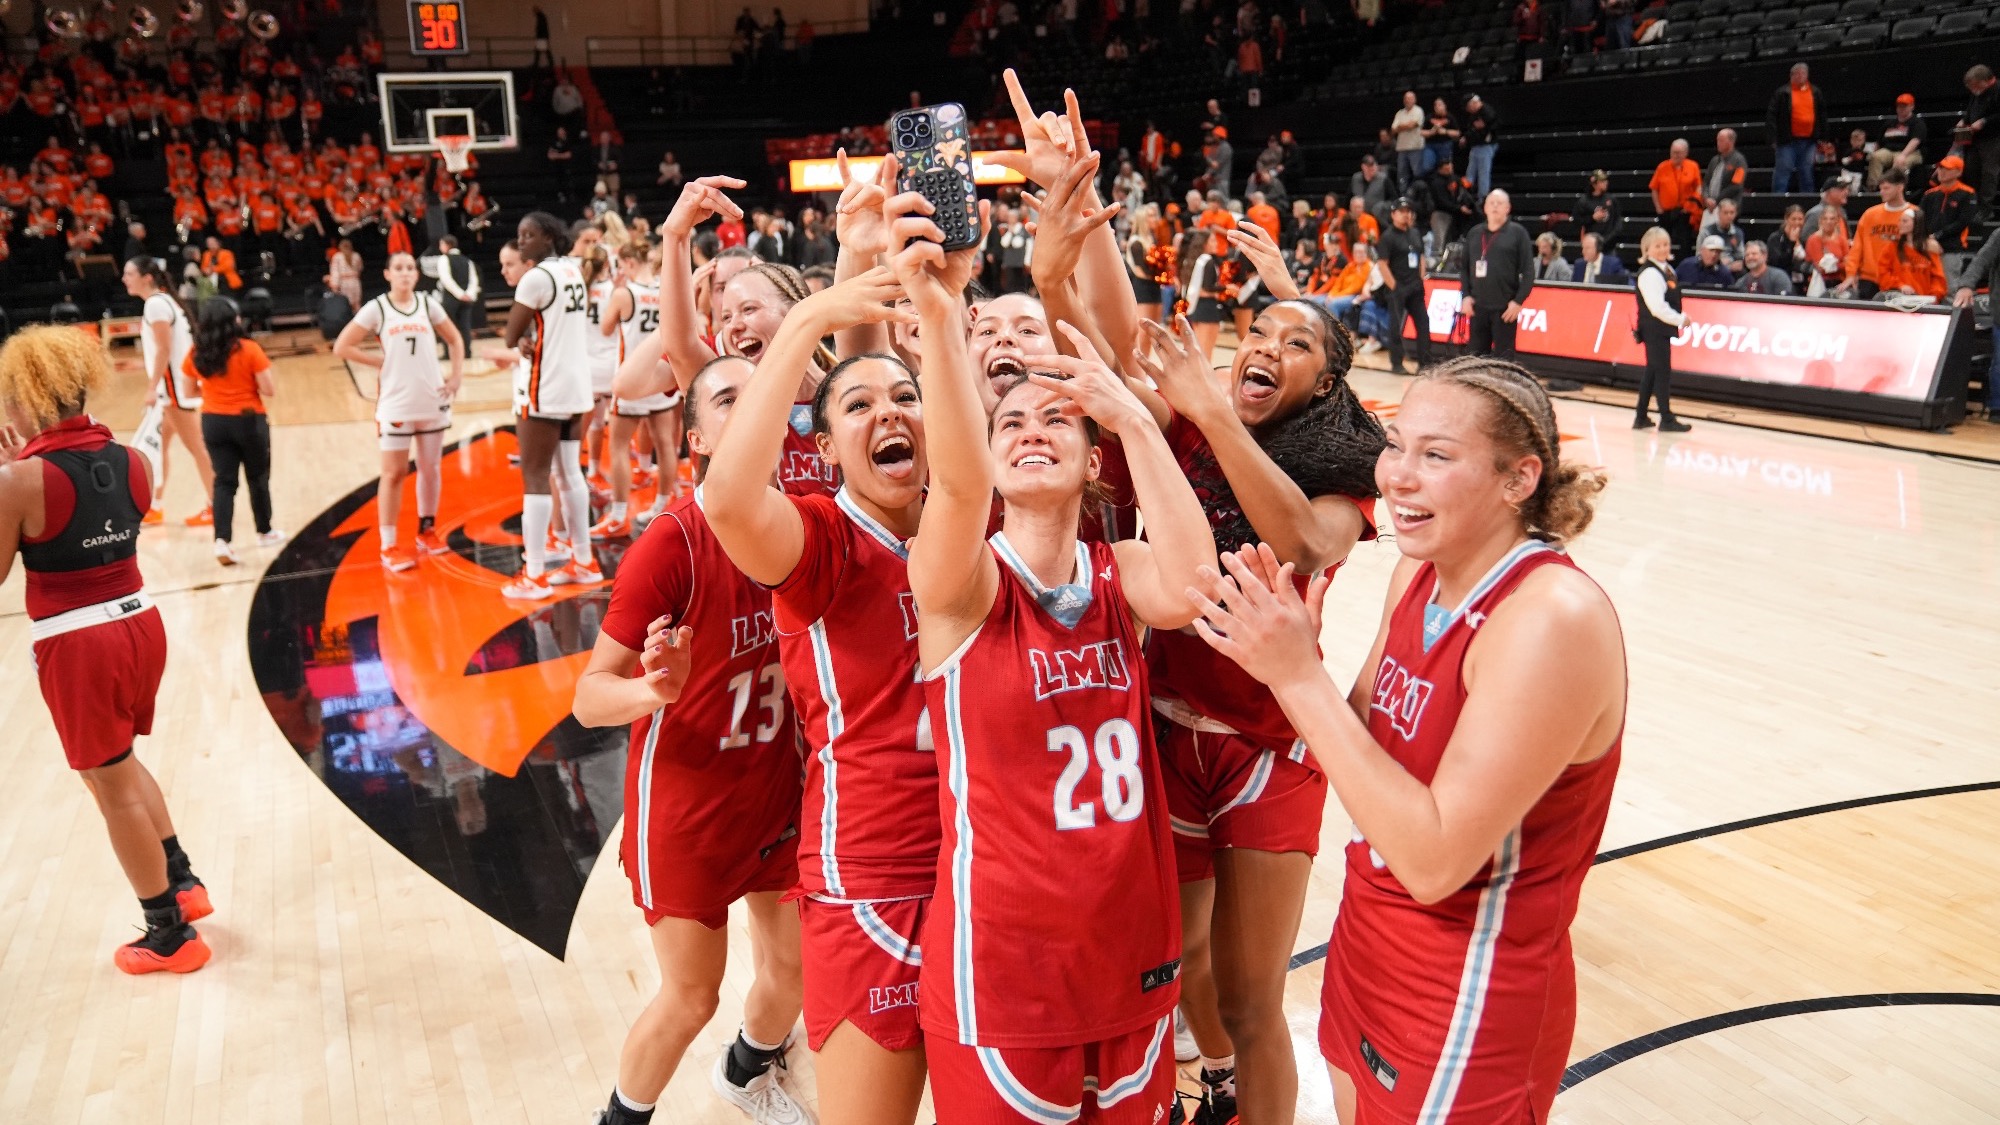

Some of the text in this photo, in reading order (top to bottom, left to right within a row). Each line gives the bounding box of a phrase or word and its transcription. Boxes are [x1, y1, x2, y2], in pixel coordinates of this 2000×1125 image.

[421, 20, 457, 49] 30
[564, 283, 584, 313] 32
[405, 337, 416, 355] 7
[1670, 322, 1849, 362] OYOTA.COM
[82, 529, 131, 549] CATAPULT
[1054, 600, 1083, 612] adidas
[730, 608, 777, 660] LM
[1029, 638, 1132, 702] LMU
[719, 662, 786, 752] 13
[1371, 655, 1435, 742] LMU
[1047, 717, 1144, 831] 28
